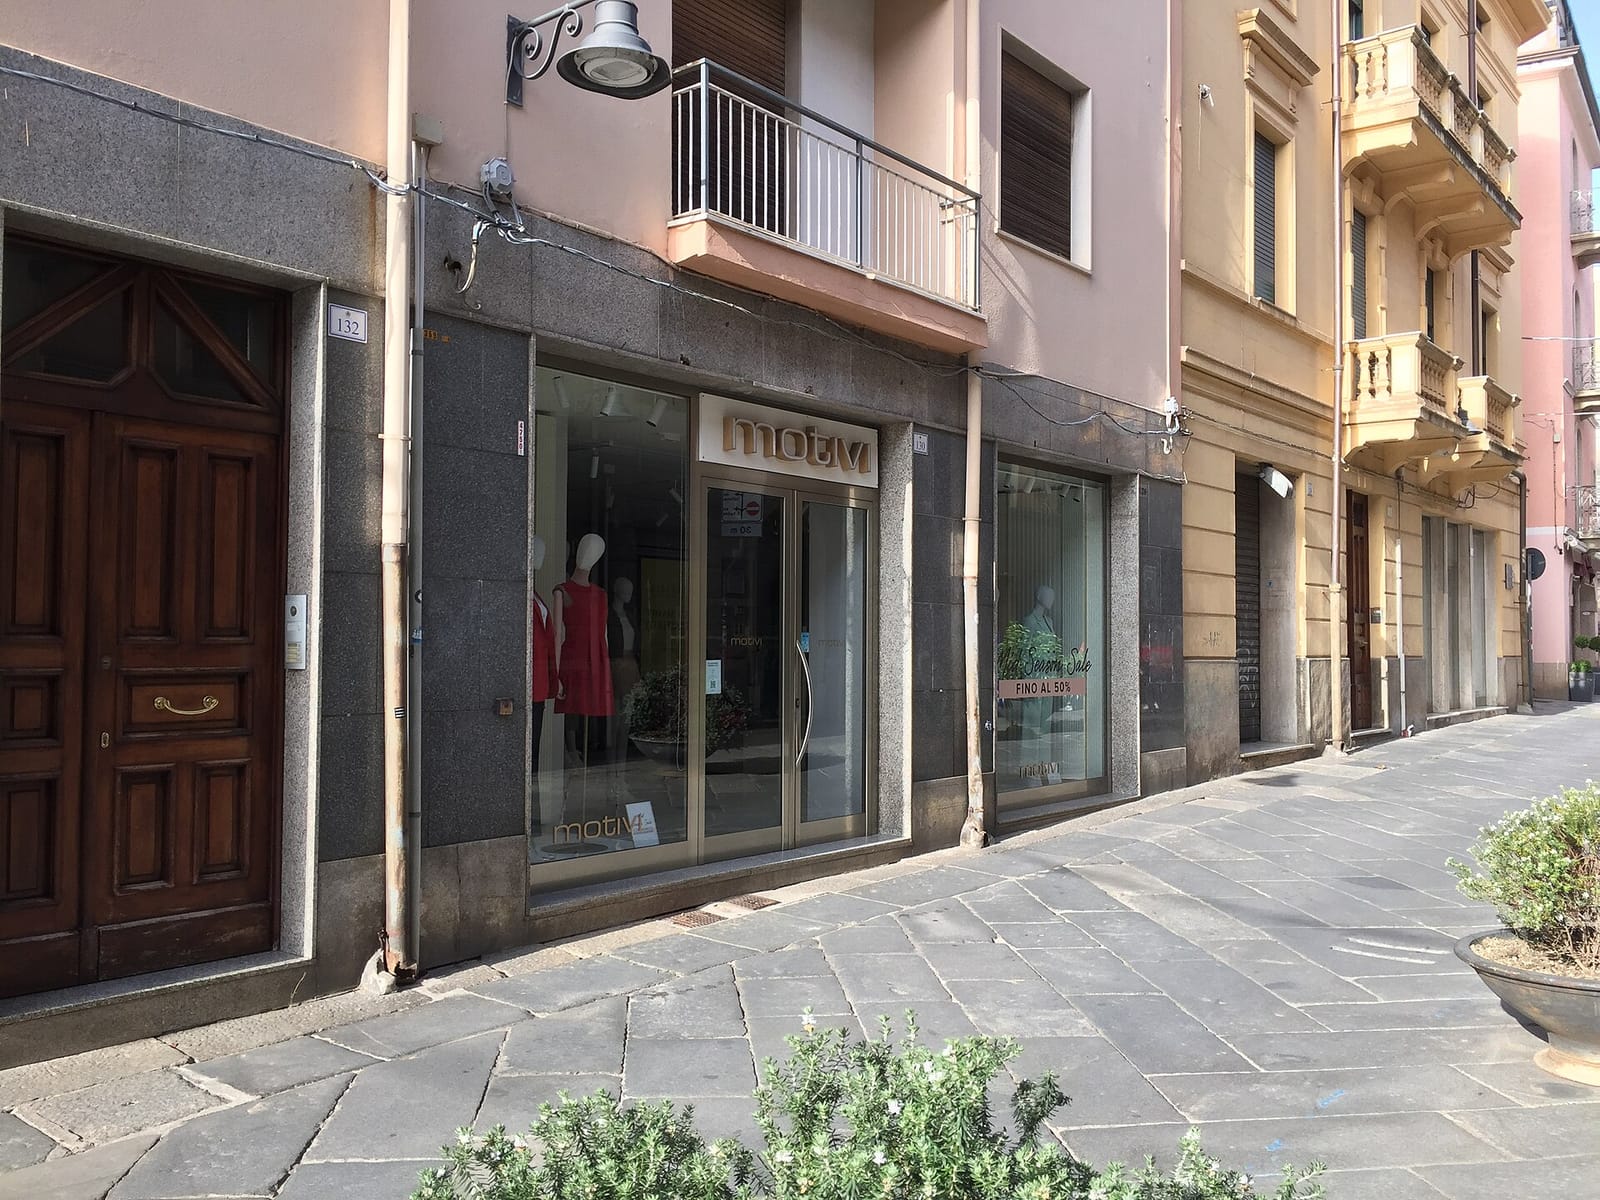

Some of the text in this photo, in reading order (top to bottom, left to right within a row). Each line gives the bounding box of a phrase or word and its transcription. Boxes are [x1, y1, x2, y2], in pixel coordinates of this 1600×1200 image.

[338, 318, 359, 335] 132
[1067, 647, 1092, 675] Sale
[1016, 681, 1071, 694] FINO AL 50%
